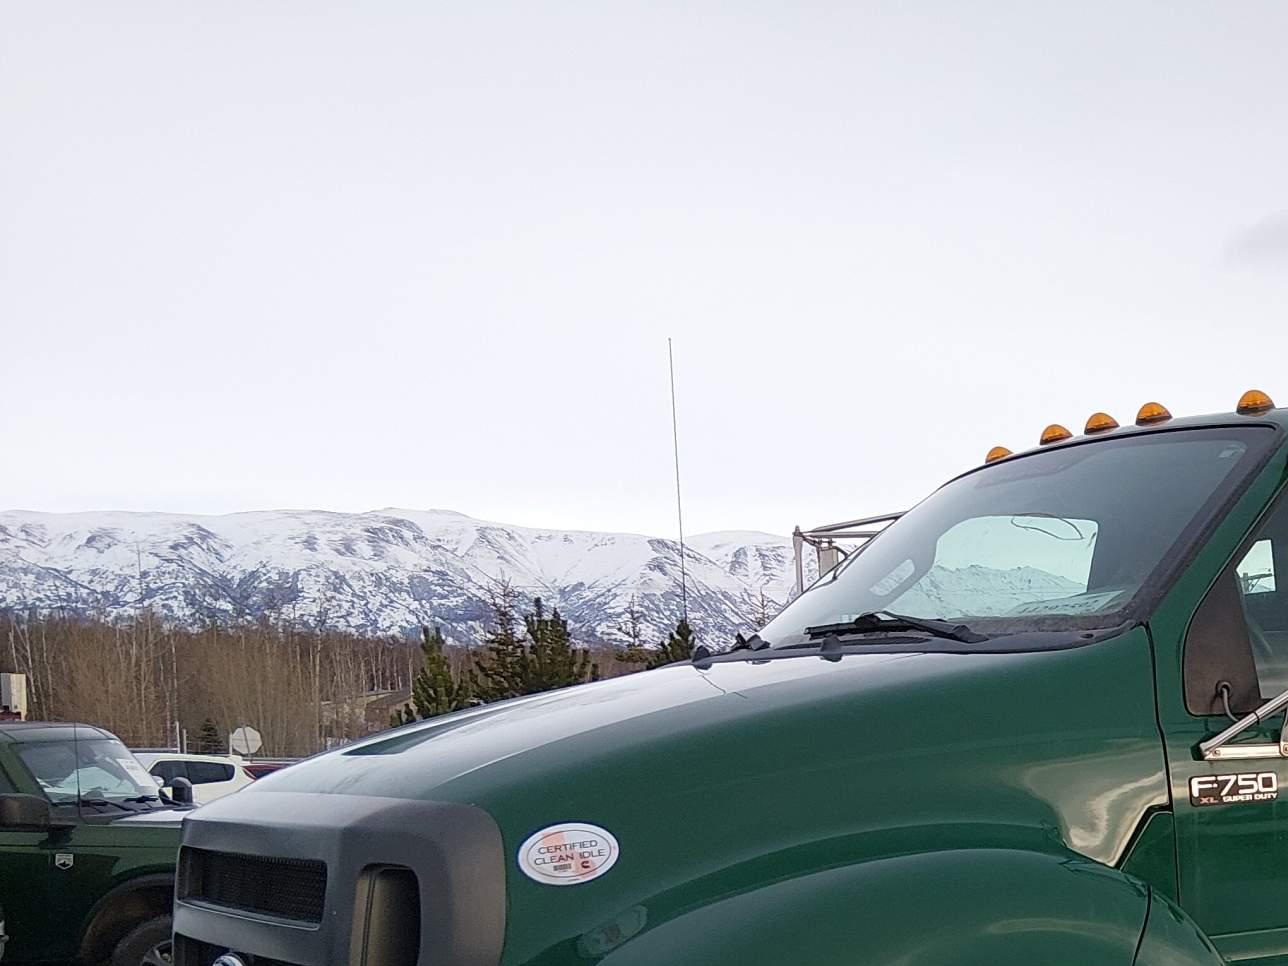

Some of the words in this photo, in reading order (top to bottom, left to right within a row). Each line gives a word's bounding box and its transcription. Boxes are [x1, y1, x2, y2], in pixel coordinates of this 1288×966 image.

[1200, 796, 1219, 804] XL
[1222, 794, 1252, 802] SUPER
[1254, 792, 1277, 800] DUTY
[538, 840, 597, 854] CERTIFIED
[534, 853, 574, 865] CLEAN
[580, 848, 606, 859] IDLE
